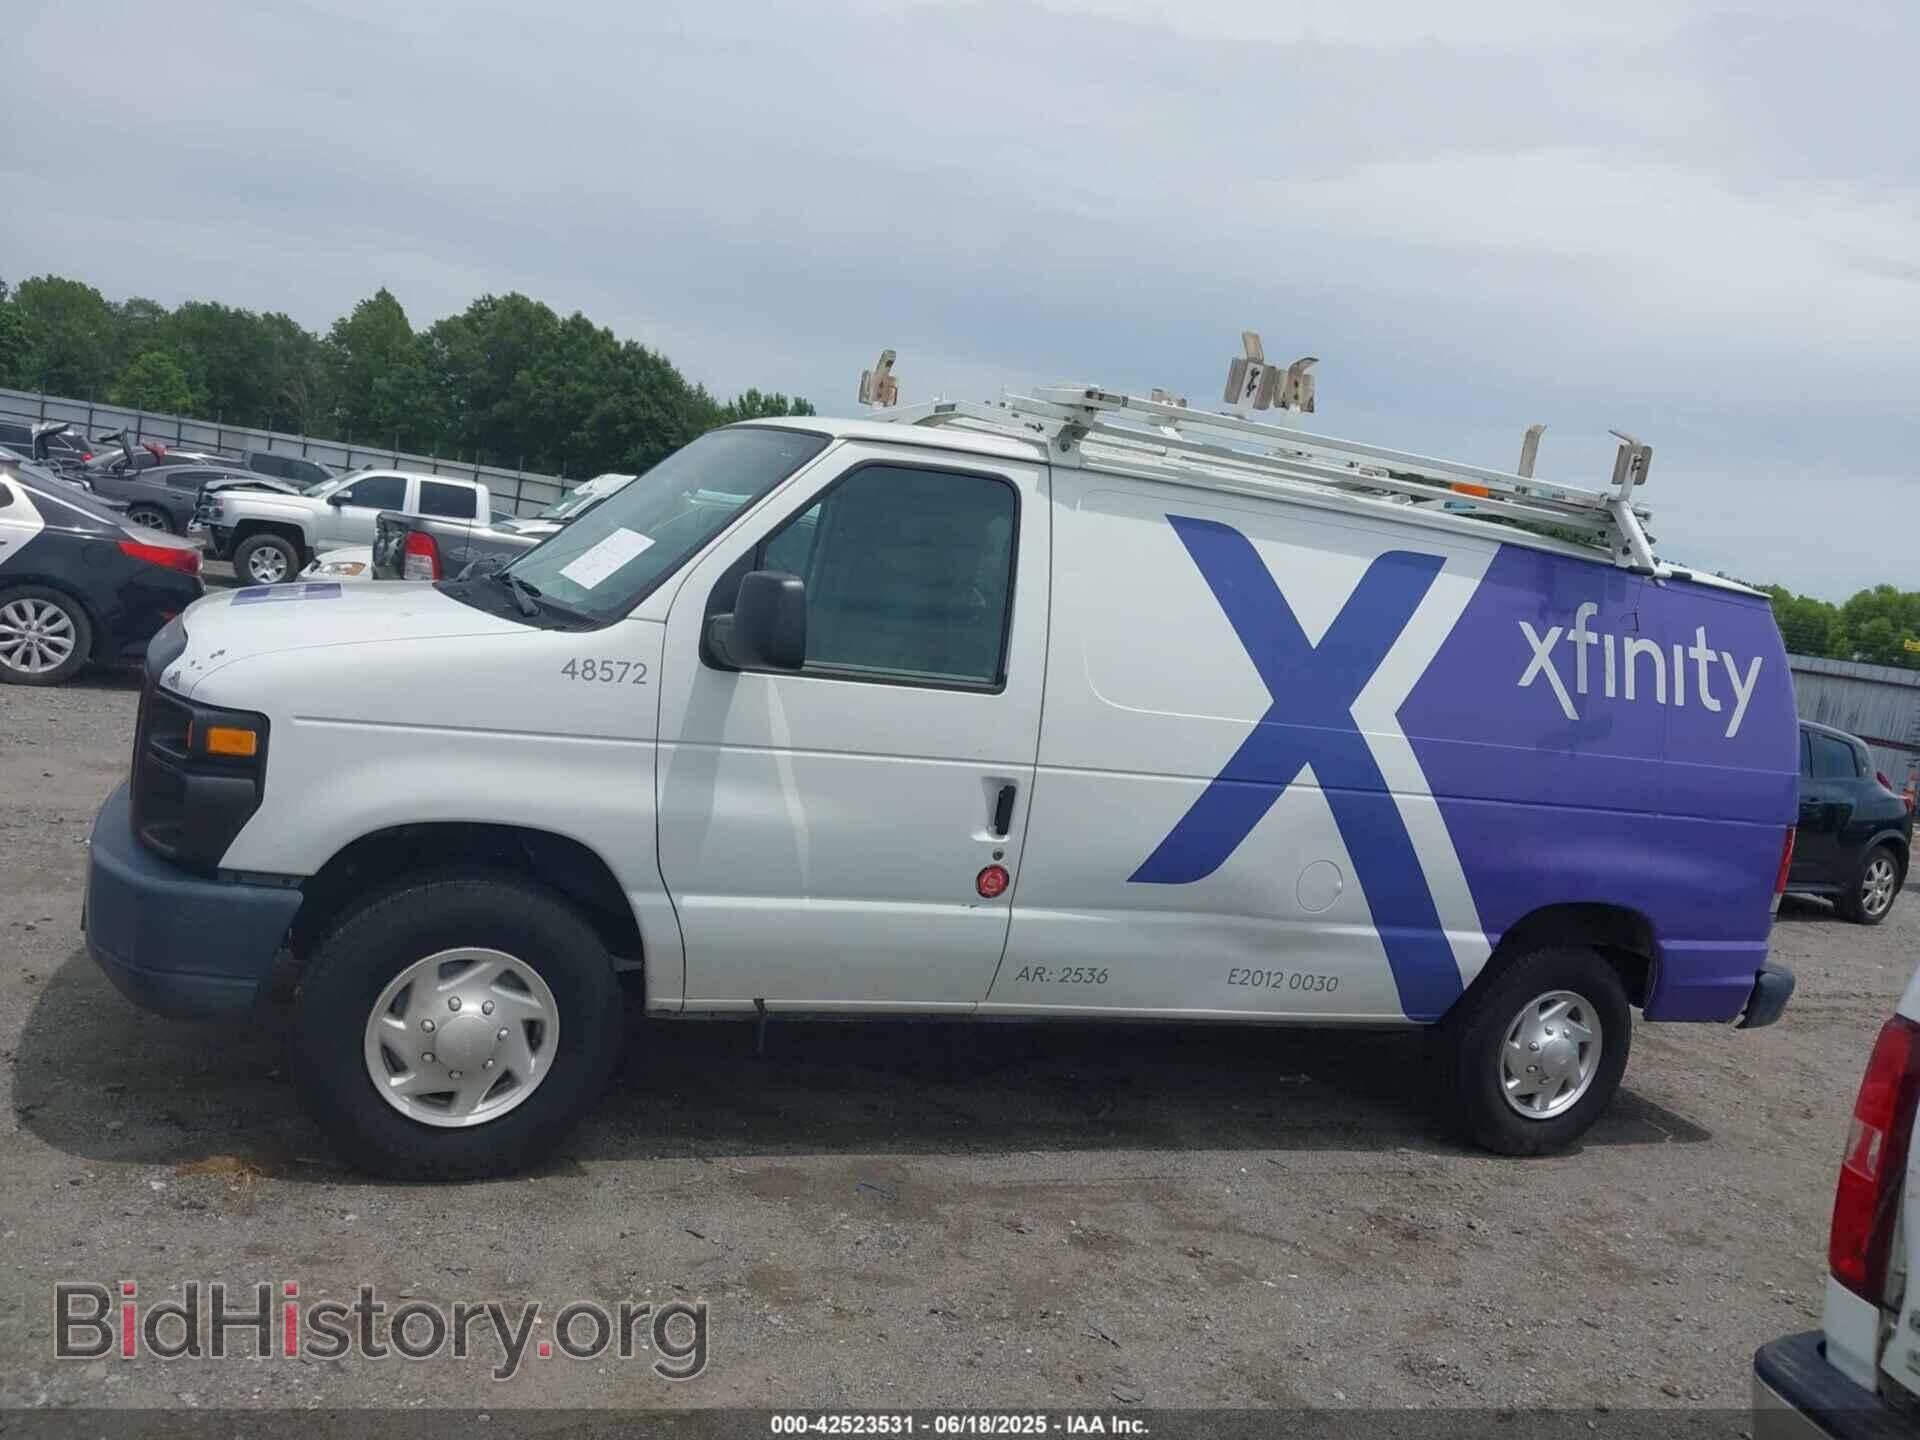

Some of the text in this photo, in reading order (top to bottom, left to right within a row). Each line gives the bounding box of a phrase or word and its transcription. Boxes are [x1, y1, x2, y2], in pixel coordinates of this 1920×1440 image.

[561, 658, 647, 685] 48572
[1518, 602, 1763, 738] xfinity
[1016, 966, 1109, 984] AR: 2536
[1227, 968, 1339, 993] E2012 0030
